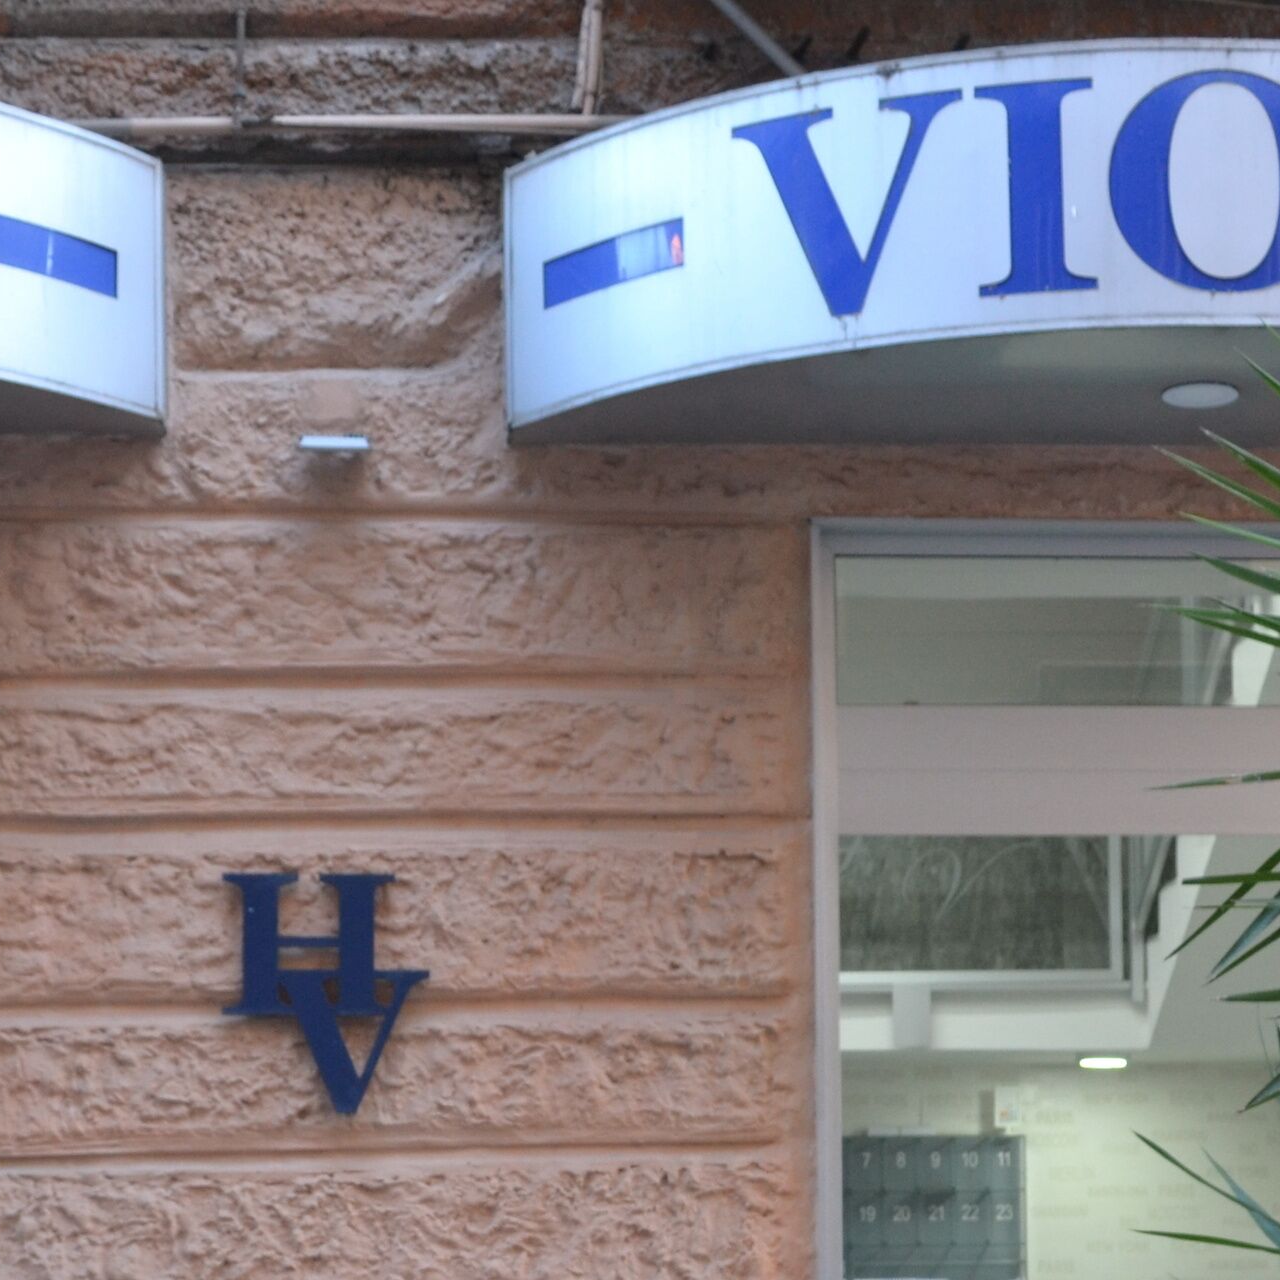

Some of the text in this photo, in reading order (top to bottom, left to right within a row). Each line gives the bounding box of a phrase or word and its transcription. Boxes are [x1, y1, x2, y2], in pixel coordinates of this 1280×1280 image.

[861, 1151, 1012, 1169] 7 8 9 10 11
[859, 1203, 1014, 1223] 19 20 21 22 23
